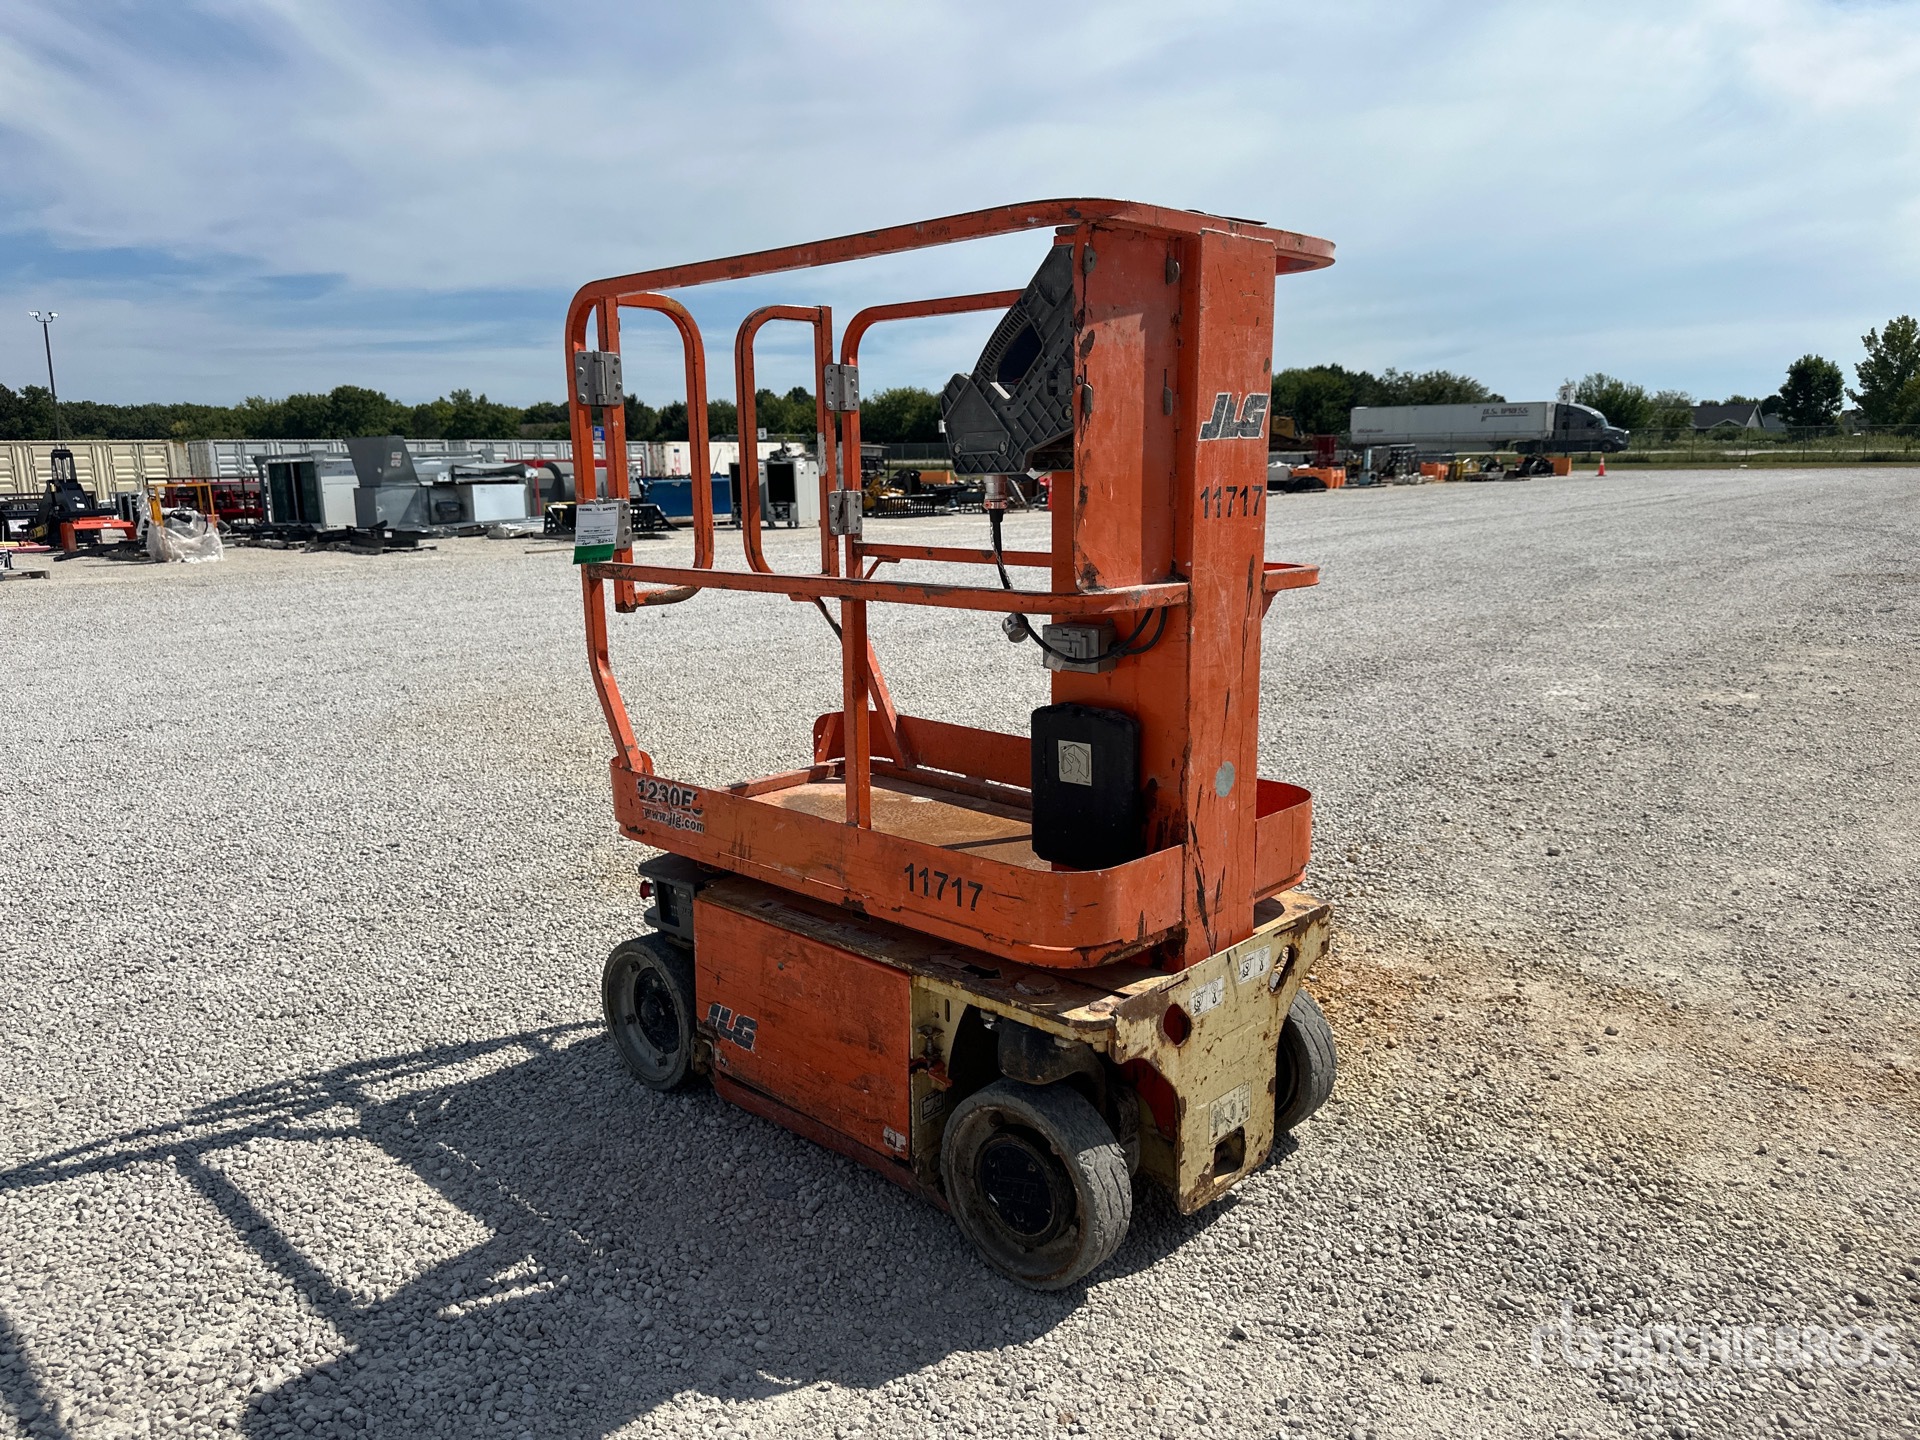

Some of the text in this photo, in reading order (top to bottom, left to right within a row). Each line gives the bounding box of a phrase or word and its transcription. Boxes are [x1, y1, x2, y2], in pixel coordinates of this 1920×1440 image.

[1198, 392, 1269, 441] JLG
[1200, 485, 1264, 519] 11717
[642, 806, 706, 835] www.jlg.com
[904, 862, 984, 912] 11717
[703, 1002, 758, 1053] JLG
